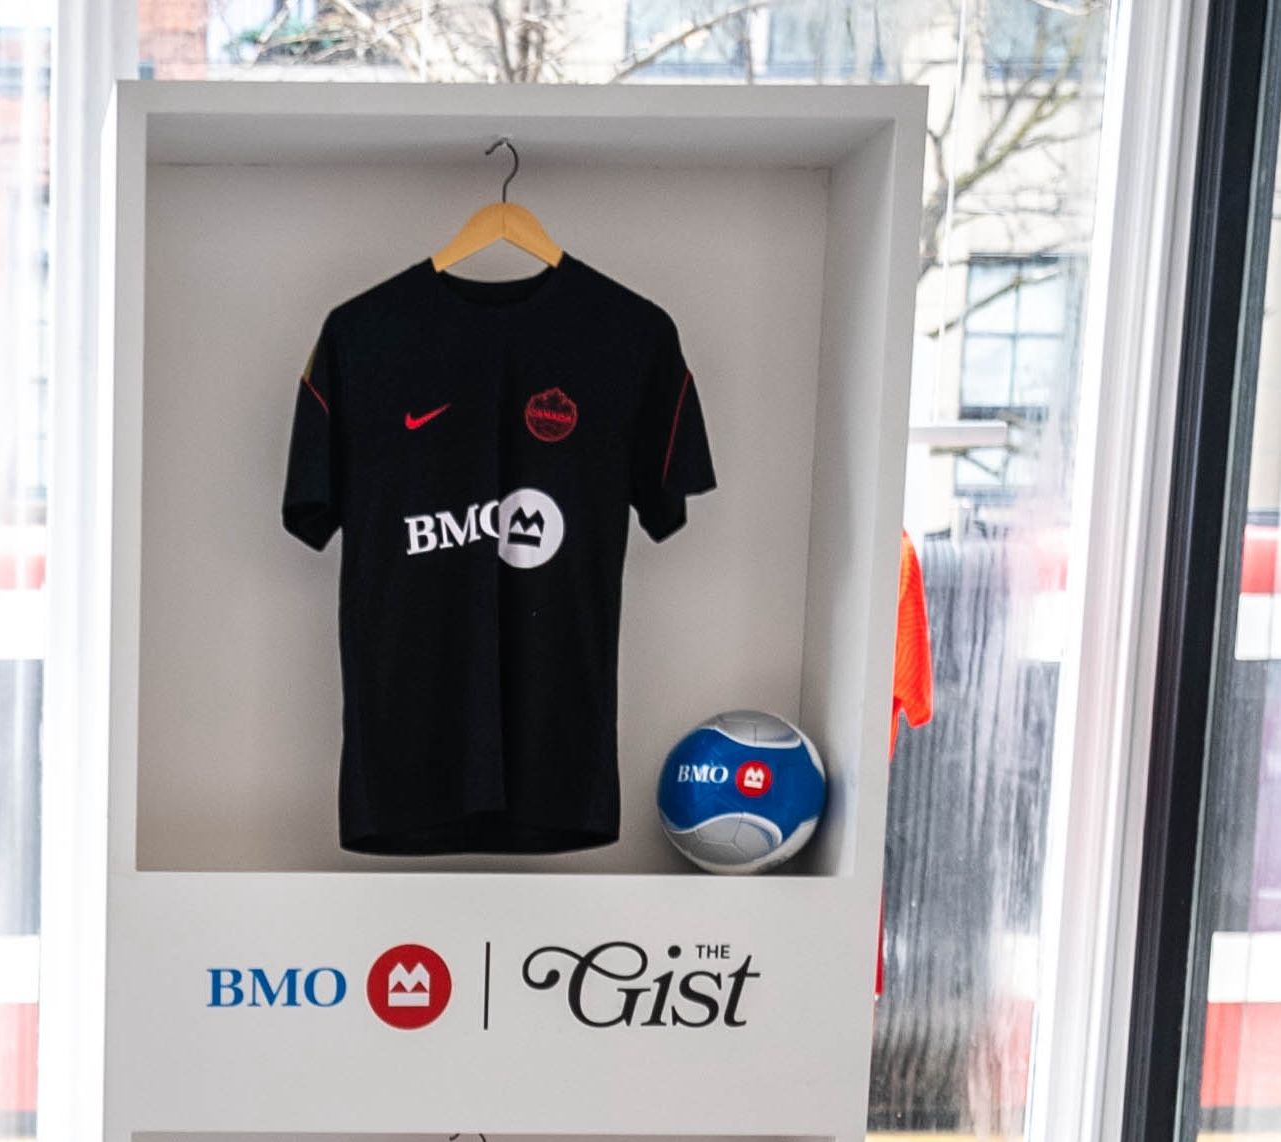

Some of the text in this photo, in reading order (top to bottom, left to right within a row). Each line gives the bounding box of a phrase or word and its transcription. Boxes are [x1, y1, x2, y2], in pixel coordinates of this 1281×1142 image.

[677, 763, 729, 784] BMO
[208, 941, 761, 1028] BMO THE Gist
